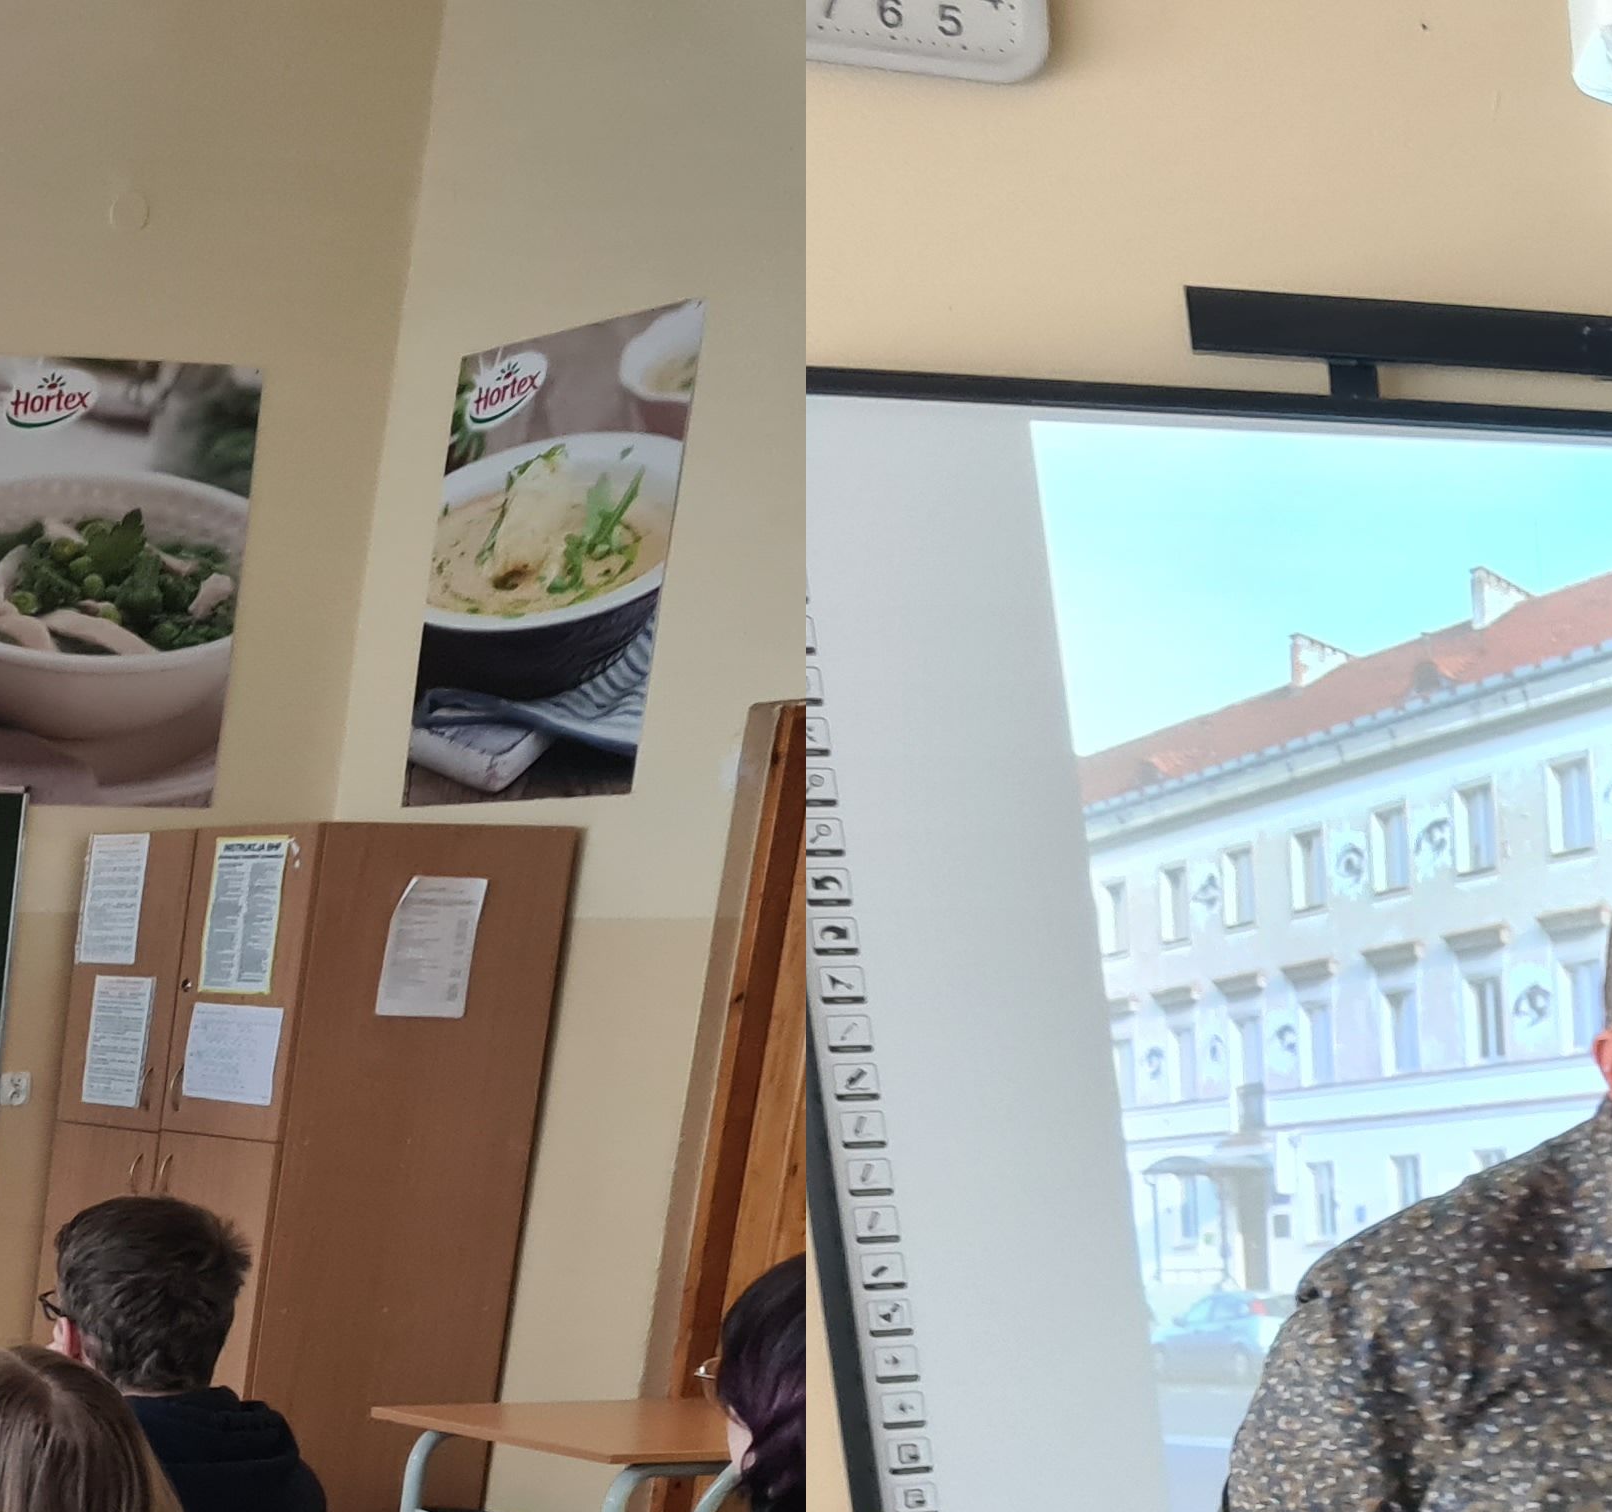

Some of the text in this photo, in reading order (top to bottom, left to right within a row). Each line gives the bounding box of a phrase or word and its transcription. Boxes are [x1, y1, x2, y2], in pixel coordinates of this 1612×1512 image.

[937, 4, 964, 37] 5
[10, 387, 92, 417] Hortex
[473, 370, 545, 414] Hortex
